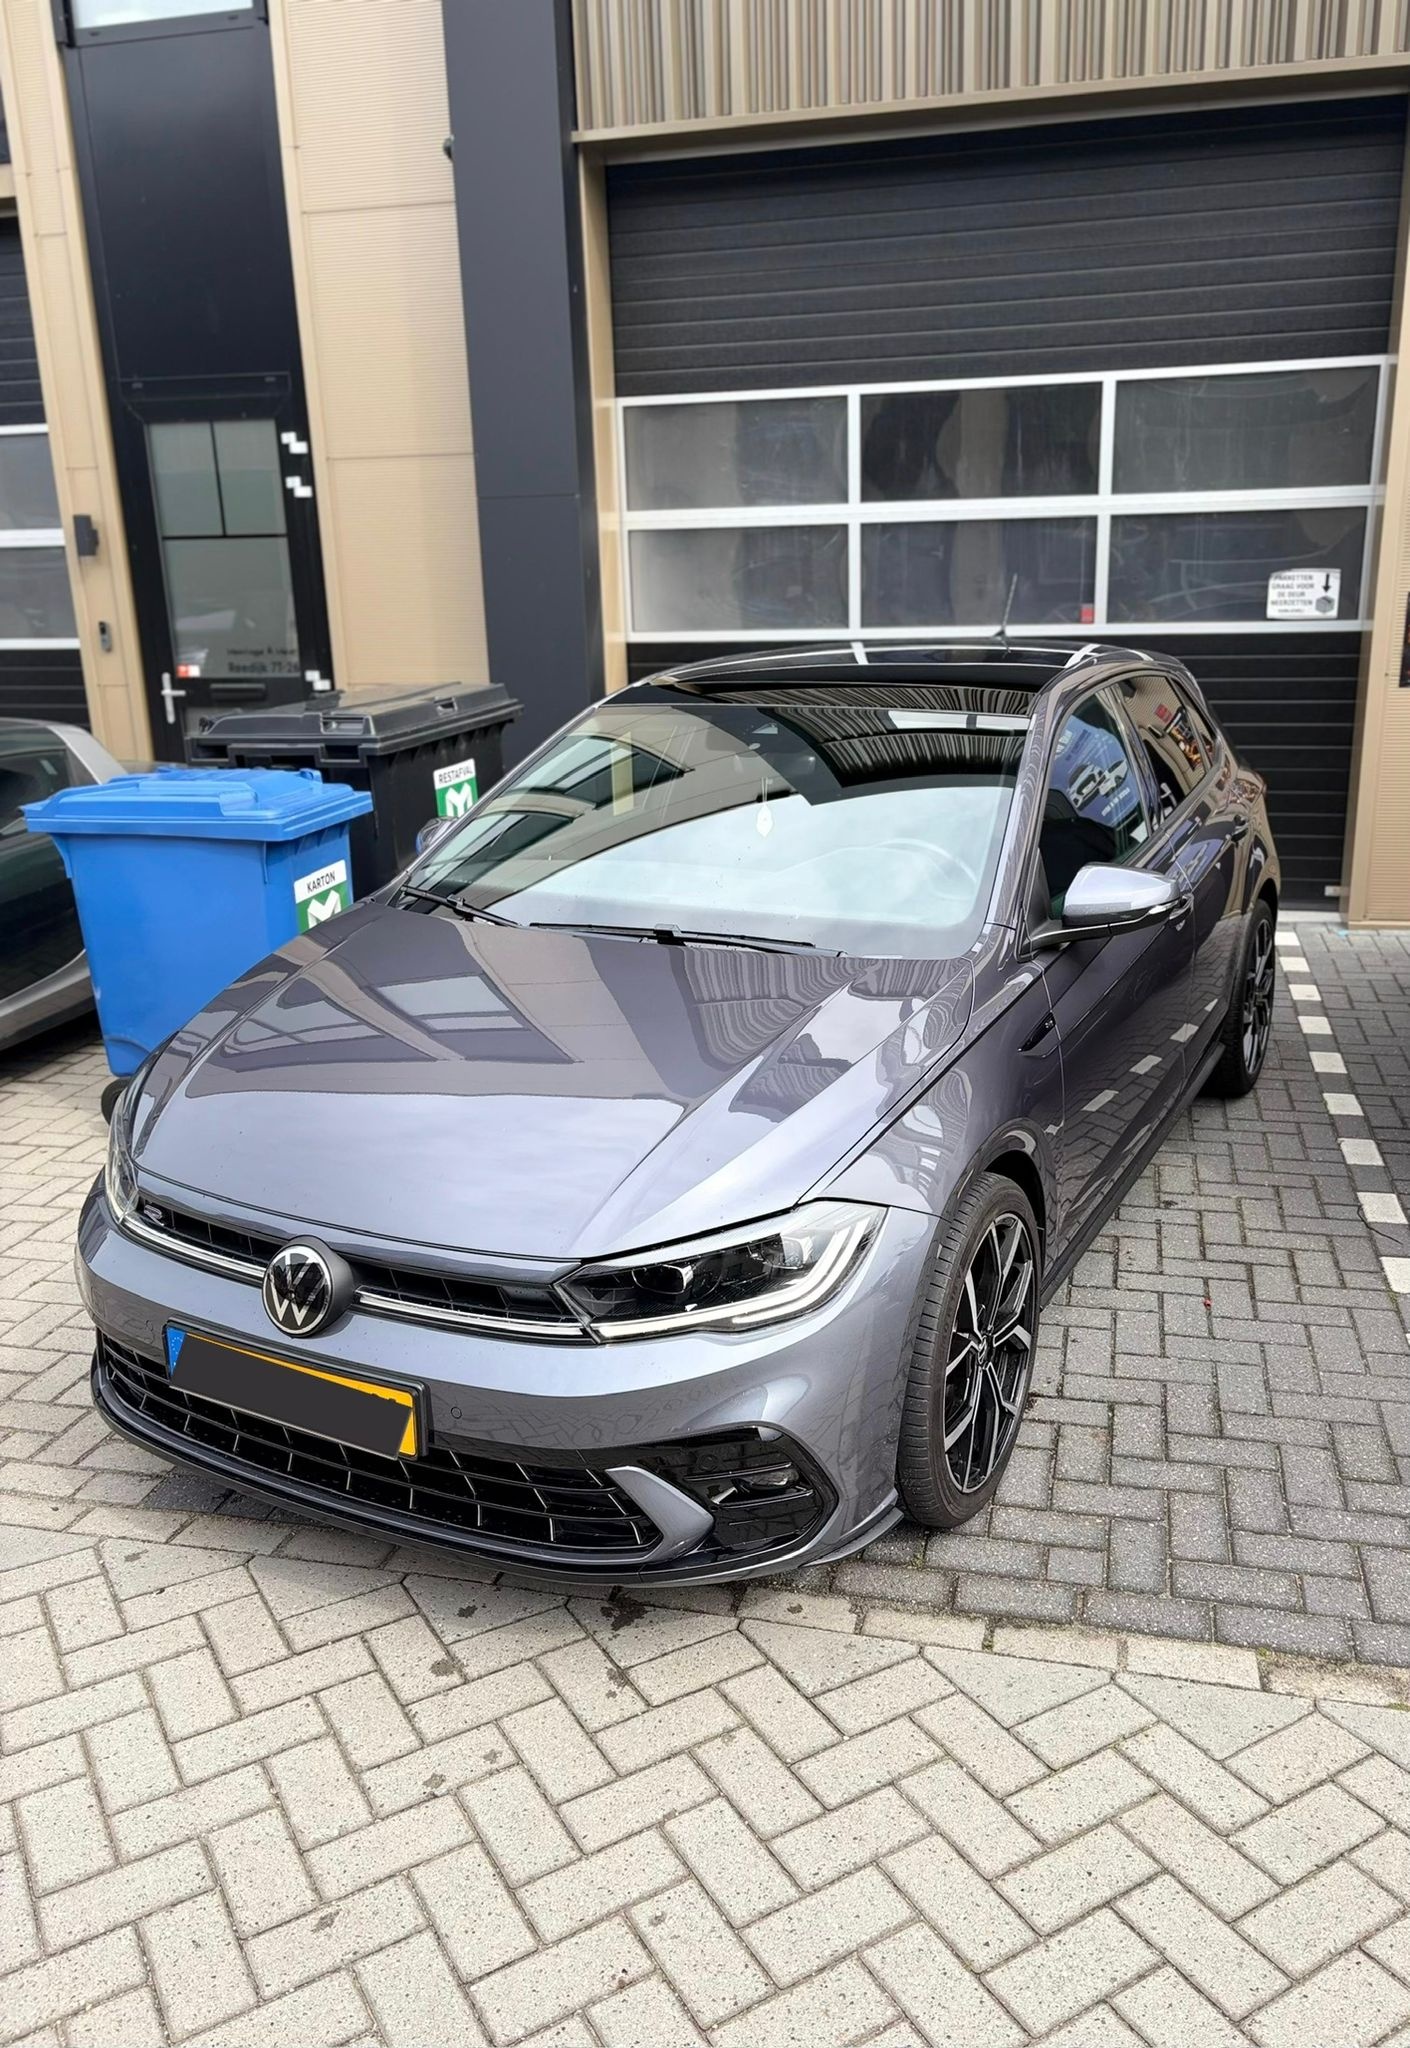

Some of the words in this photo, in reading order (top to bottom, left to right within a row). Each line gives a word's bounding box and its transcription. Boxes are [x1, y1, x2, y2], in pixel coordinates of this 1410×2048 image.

[1296, 582, 1315, 590] VOOR
[438, 766, 473, 784] RESTAFVAL
[306, 869, 336, 893] KARTON
